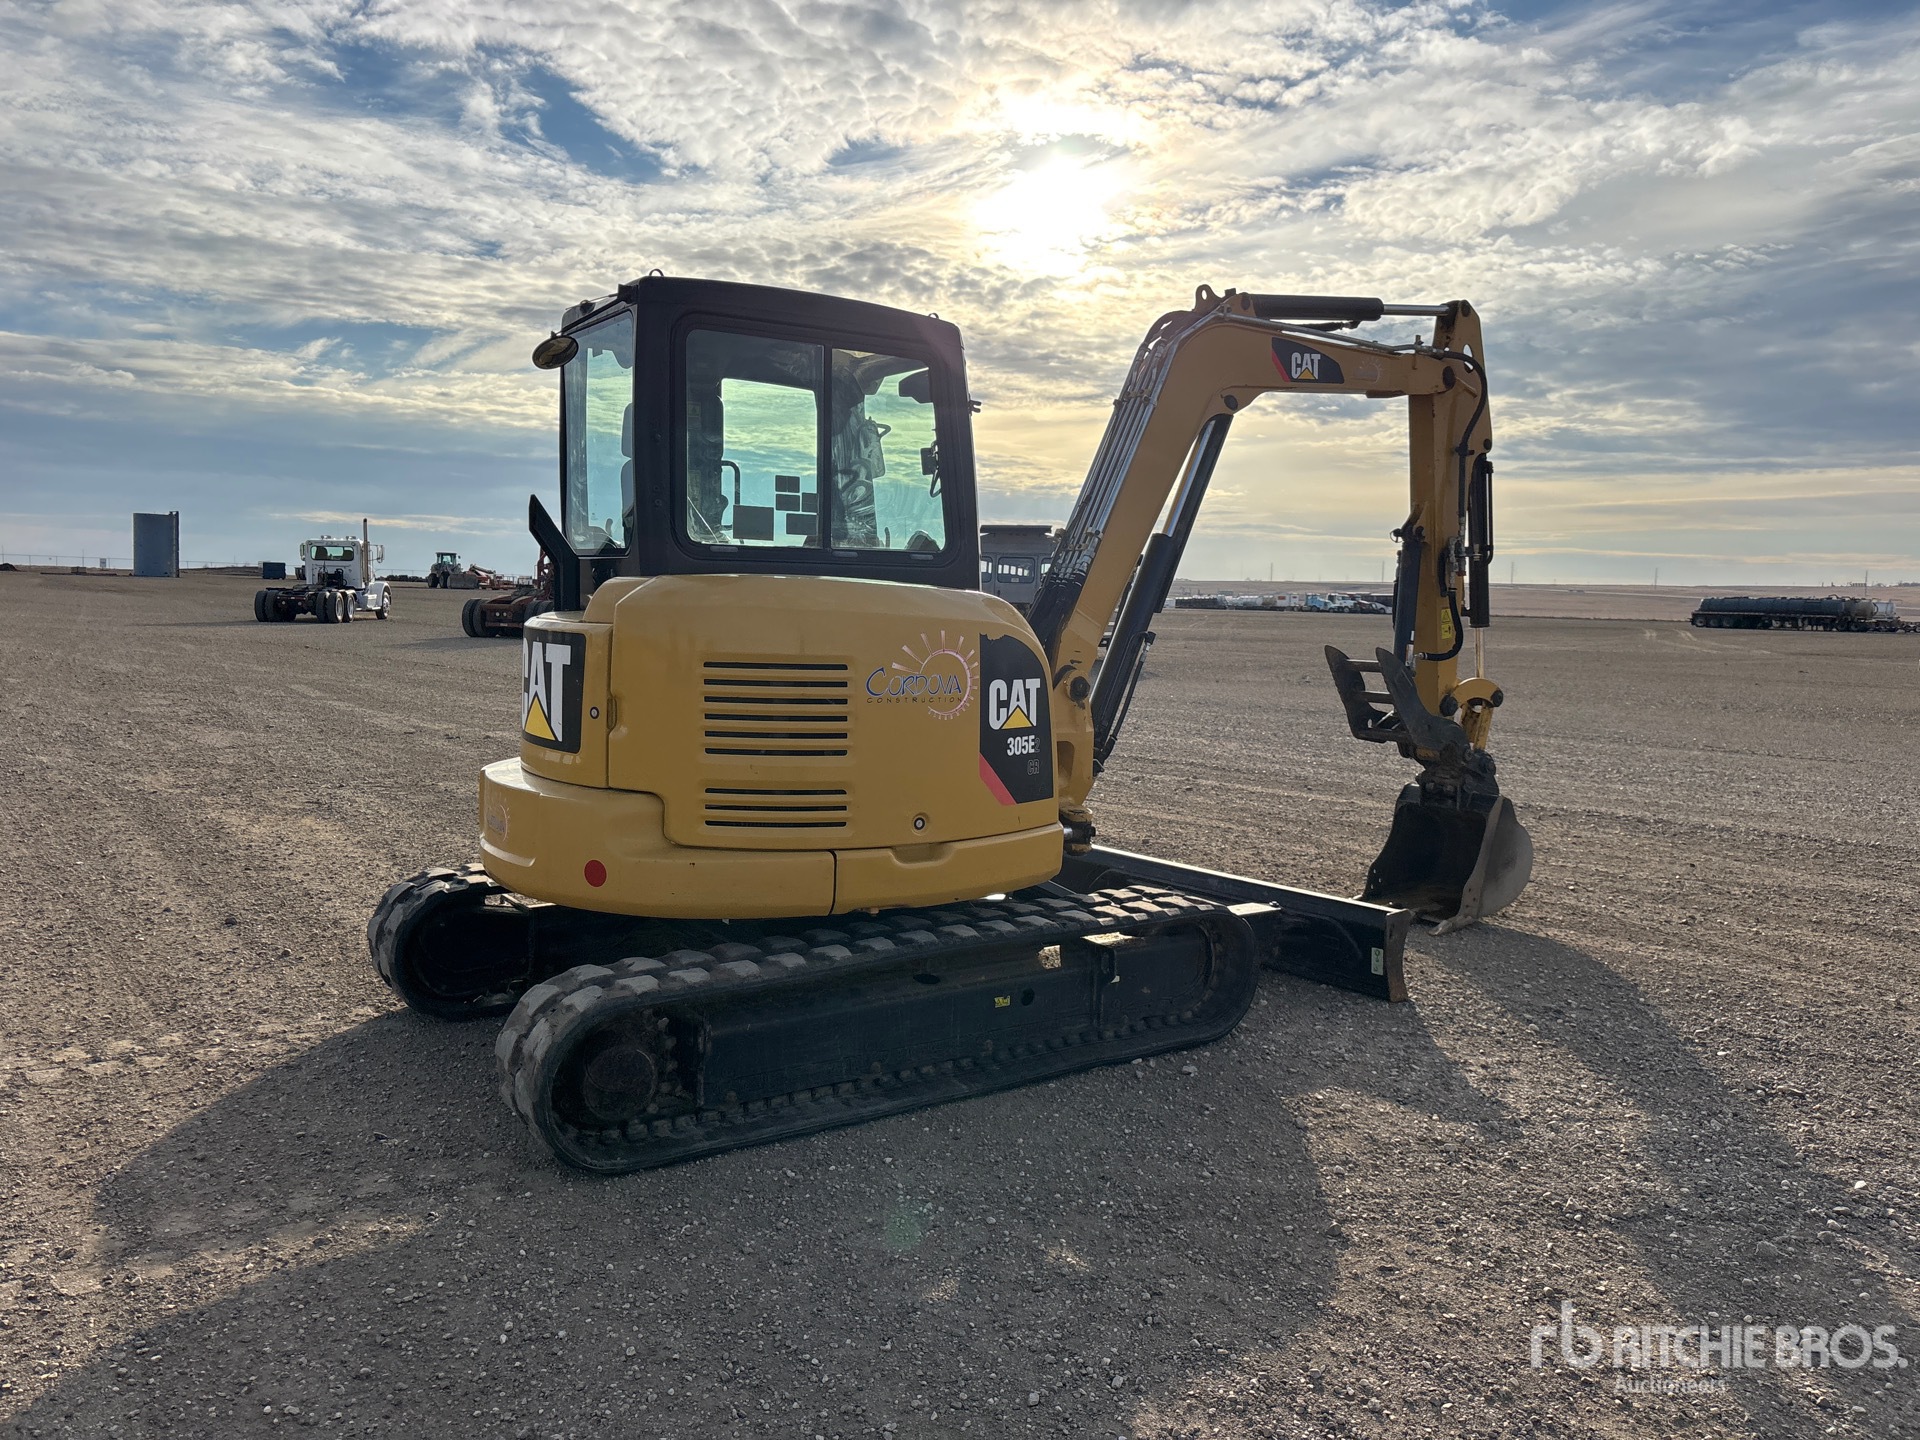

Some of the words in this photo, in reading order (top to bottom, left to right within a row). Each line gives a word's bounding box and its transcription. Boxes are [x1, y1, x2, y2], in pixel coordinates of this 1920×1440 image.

[1291, 352, 1321, 380] CAT
[866, 696, 963, 704] CONSTRUCTION
[989, 678, 1041, 730] CAT
[1027, 758, 1040, 775] CR
